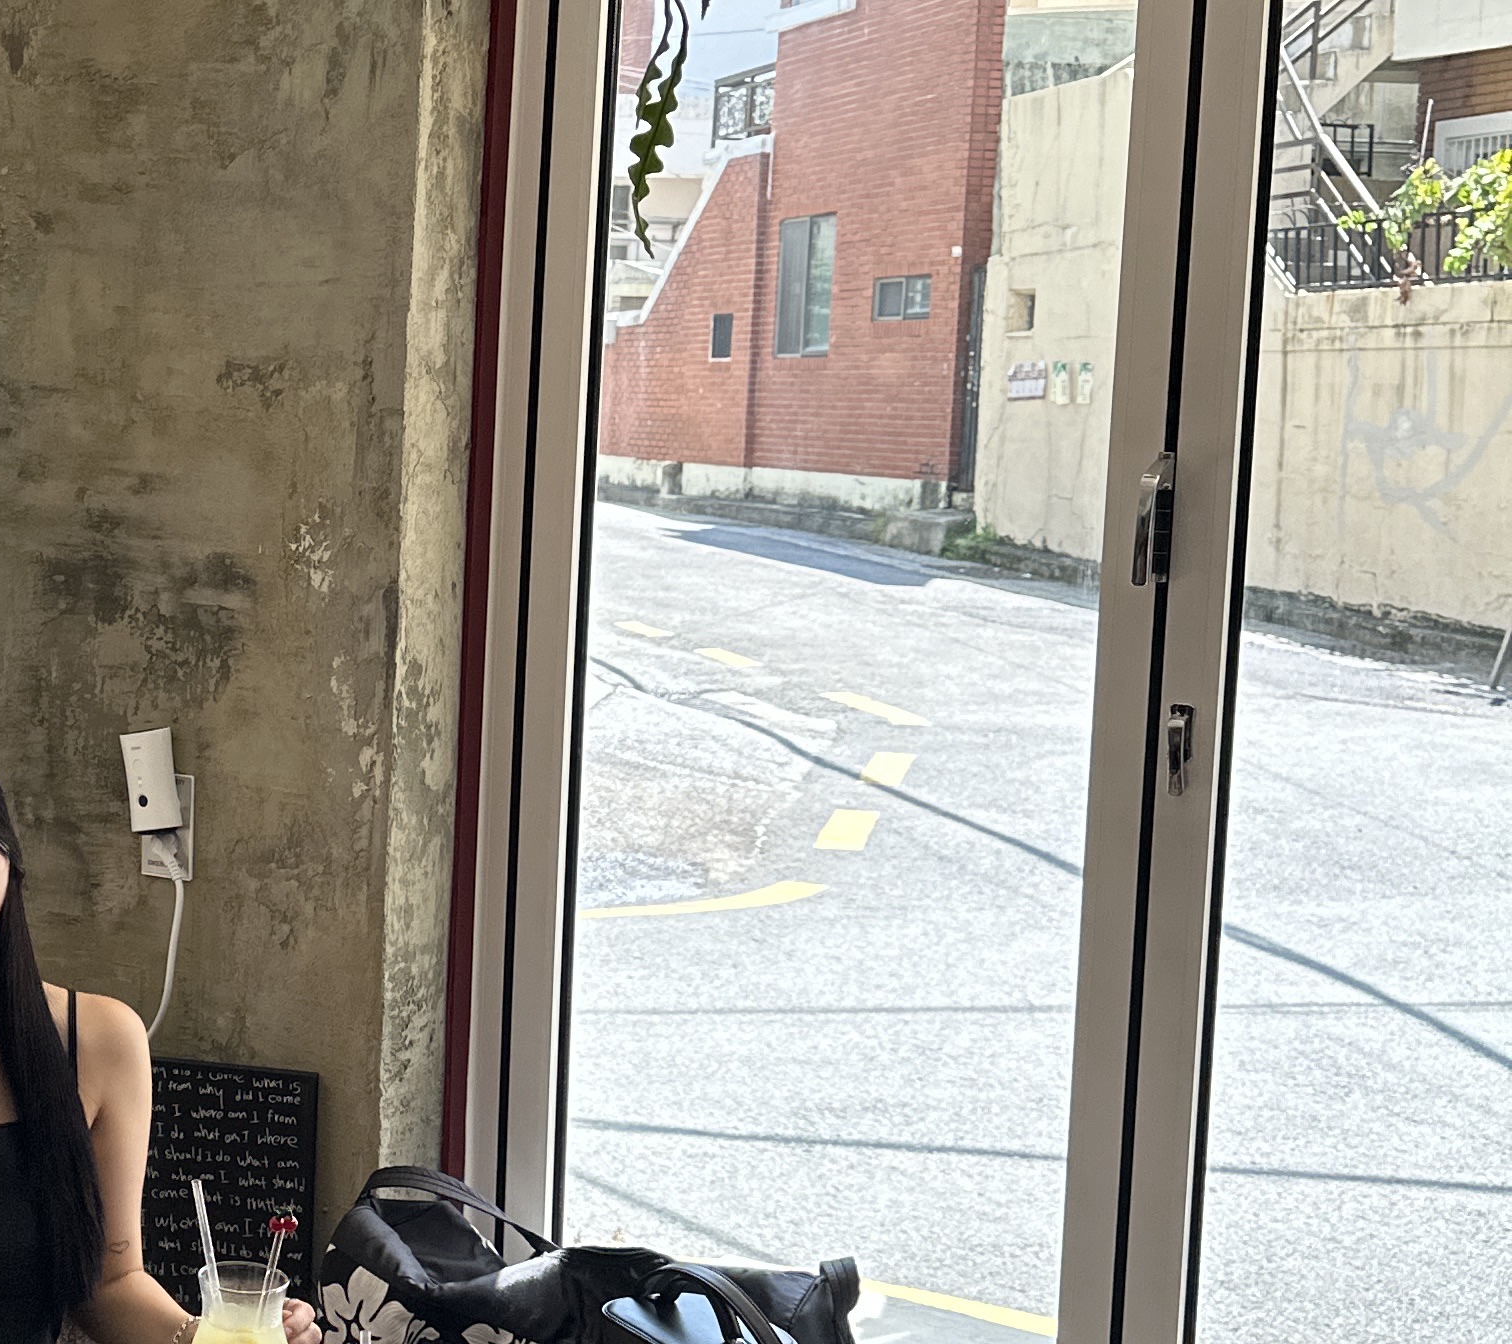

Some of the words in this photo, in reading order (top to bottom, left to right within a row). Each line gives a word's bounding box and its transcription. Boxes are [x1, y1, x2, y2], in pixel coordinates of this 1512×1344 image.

[168, 1080, 192, 1092] from
[198, 1084, 224, 1109] why
[235, 1088, 253, 1102] did
[268, 1094, 301, 1106] come
[252, 1076, 283, 1089] what
[289, 1081, 302, 1094] is
[190, 1106, 224, 1121] where
[267, 1109, 298, 1126] from
[193, 1124, 221, 1141] what
[257, 1127, 300, 1149] where
[164, 1146, 202, 1163] should
[215, 1149, 231, 1162] do
[237, 1148, 270, 1168] what
[276, 1159, 300, 1169] am
[238, 1171, 269, 1191] what
[150, 1186, 189, 1199] come
[228, 1192, 241, 1206] is
[214, 1221, 240, 1233] am
[242, 1217, 253, 1238] I
